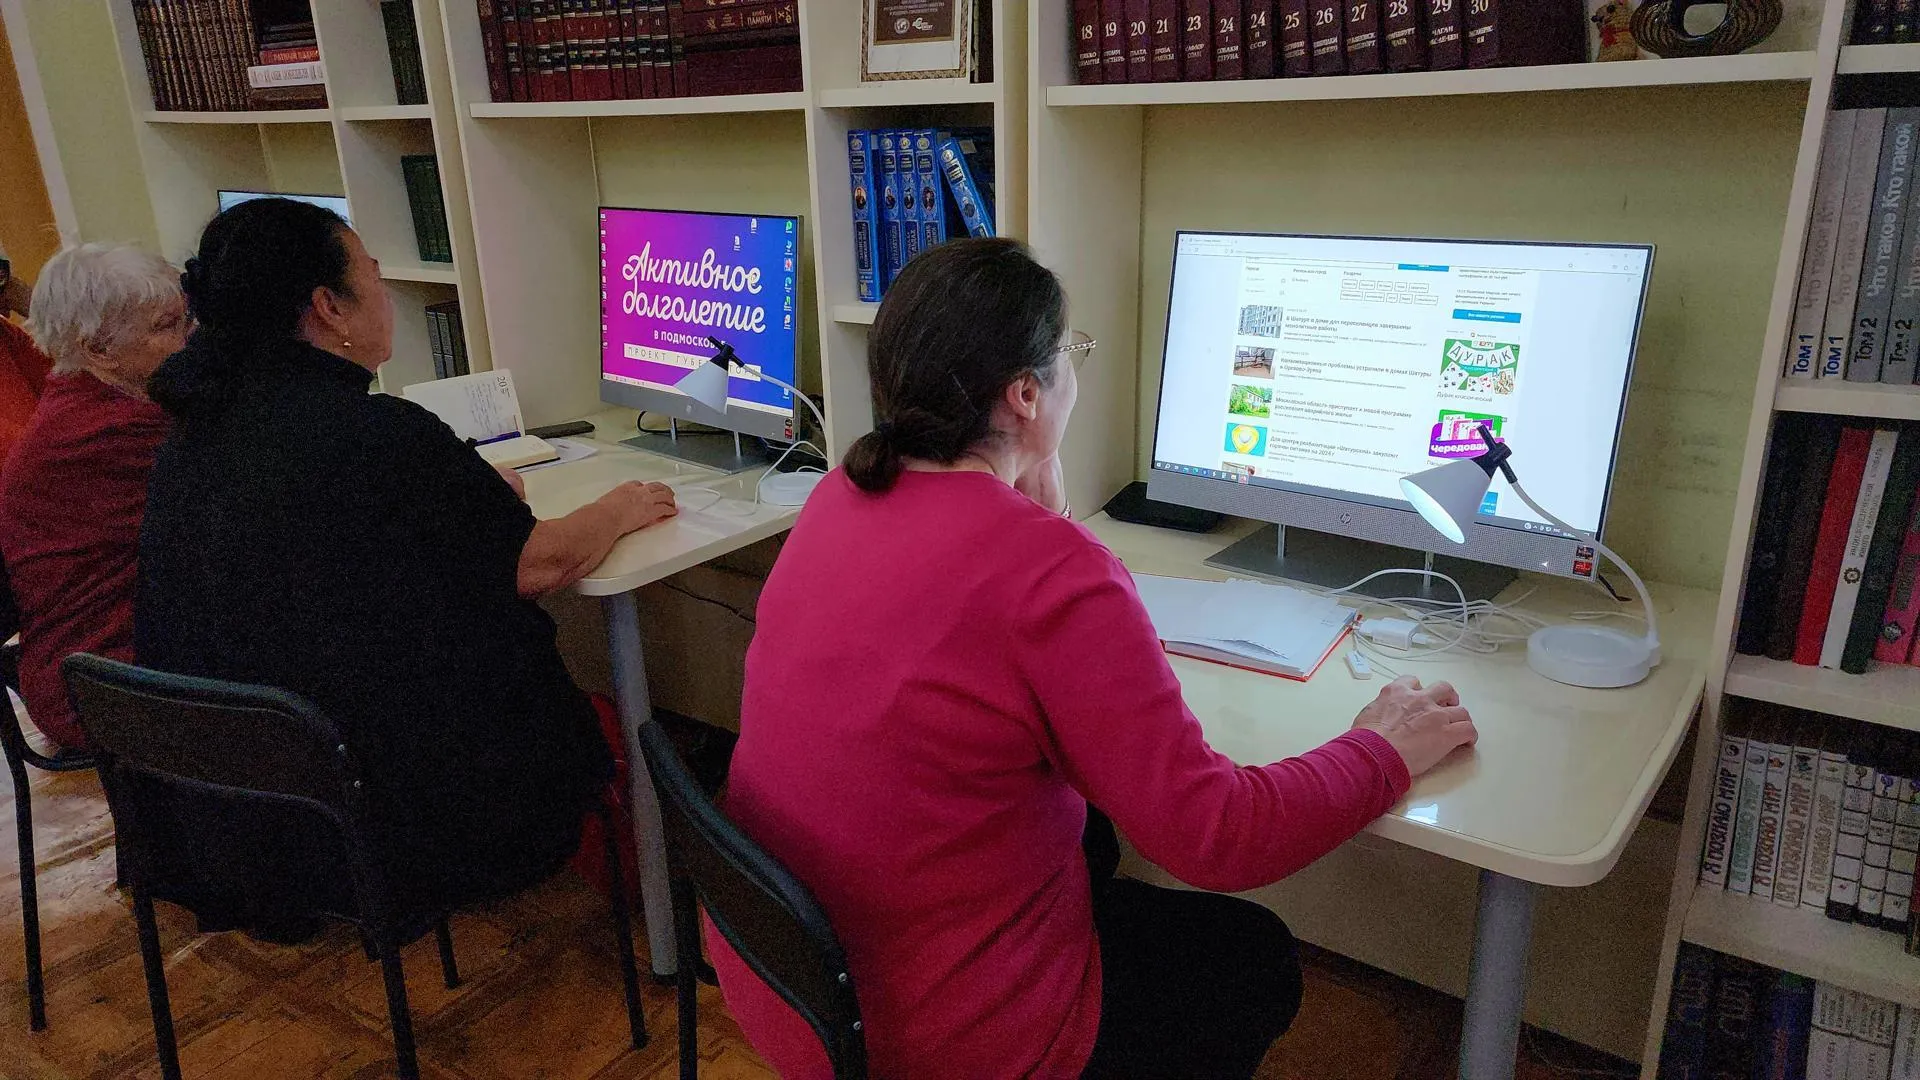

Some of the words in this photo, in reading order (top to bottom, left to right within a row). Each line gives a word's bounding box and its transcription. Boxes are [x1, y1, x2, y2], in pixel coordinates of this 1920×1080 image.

[1250, 11, 1266, 29] 24
[1285, 12, 1300, 30] 25
[1316, 8, 1334, 27] 26
[1351, 4, 1368, 23] 27
[1081, 24, 1093, 40] 18
[1105, 22, 1117, 37] 19
[1130, 20, 1146, 37] 20
[1156, 18, 1169, 34] 21
[1187, 15, 1202, 31] 23
[1219, 17, 1234, 34] 24
[622, 241, 762, 294] Активное
[622, 276, 766, 333] долголетие
[1860, 317, 1878, 329] 2
[1895, 319, 1913, 330] 2
[654, 330, 659, 339] В
[661, 331, 727, 350] ПОДМОСКО
[1799, 334, 1814, 343] 1
[1828, 336, 1844, 345] 1
[628, 346, 666, 361] ПРОЕКТ
[1451, 344, 1511, 364] ДУРАК
[1792, 345, 1813, 375] Том
[1822, 347, 1842, 377] Том
[1719, 768, 1738, 800] МИР
[1709, 802, 1732, 861] ПОЗНАЮ
